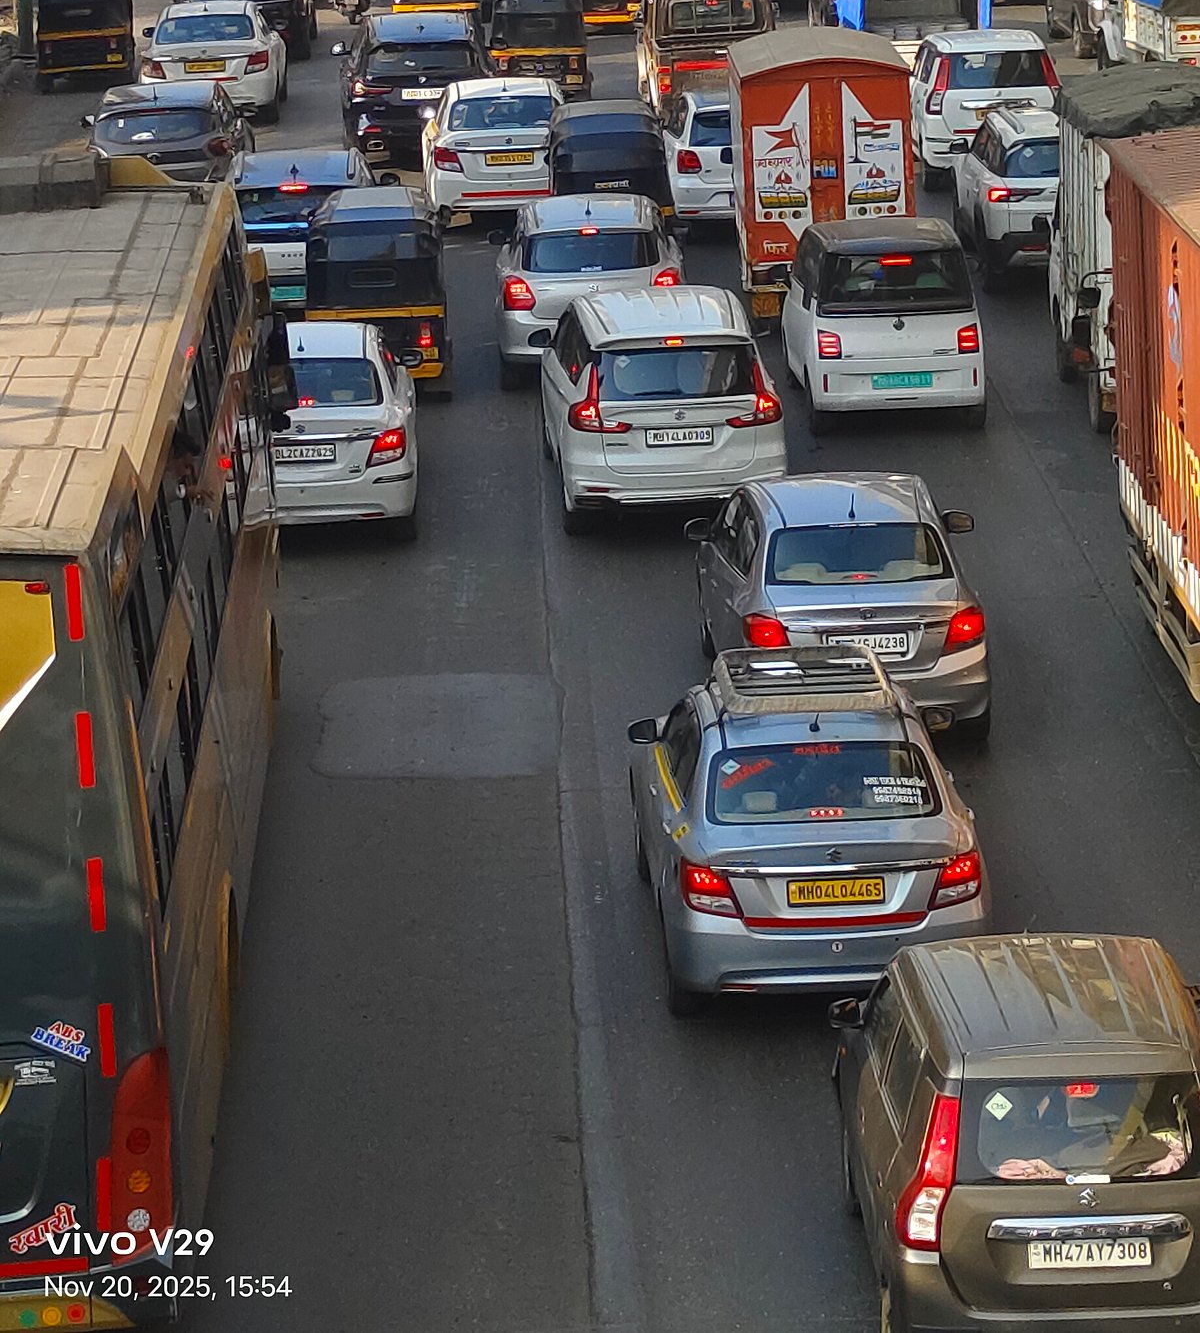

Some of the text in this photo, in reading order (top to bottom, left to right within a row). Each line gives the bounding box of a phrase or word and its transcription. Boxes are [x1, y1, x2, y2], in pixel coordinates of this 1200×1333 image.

[48, 1021, 85, 1044] ABS
[31, 1027, 91, 1062] BREAK
[1042, 1242, 1148, 1263] MH47AY7308
